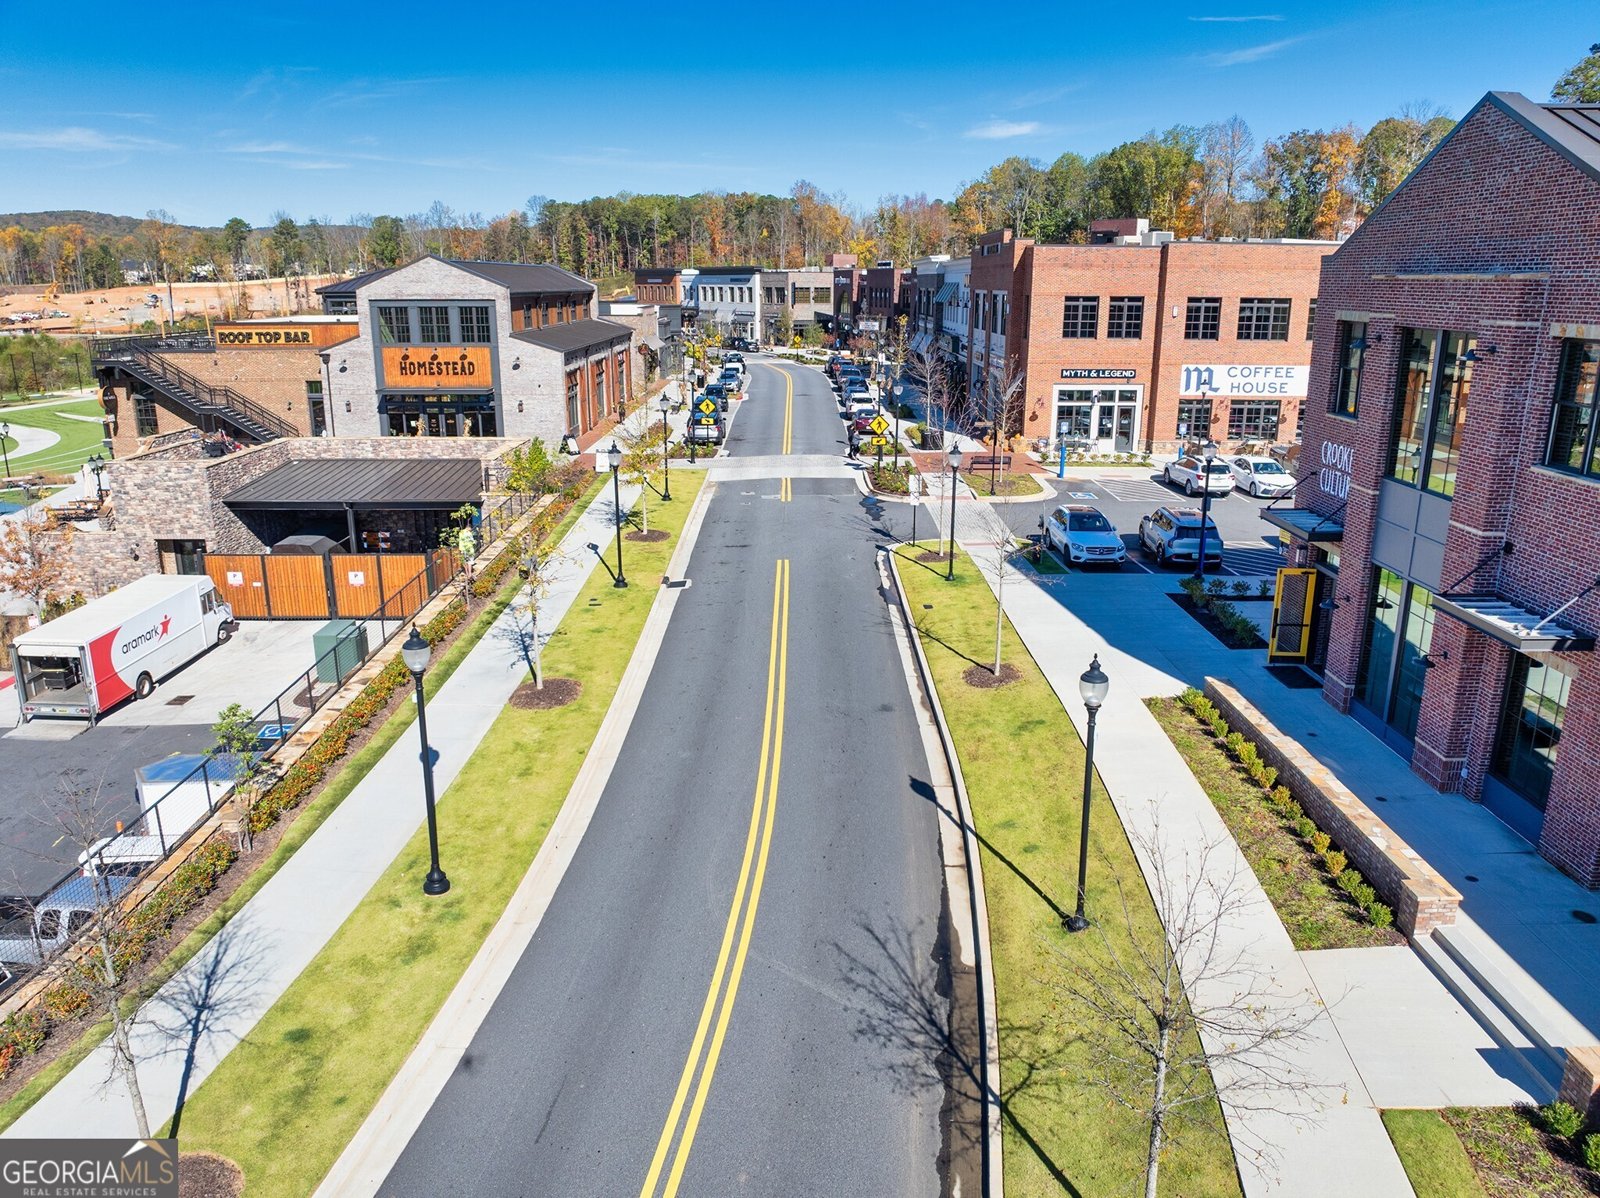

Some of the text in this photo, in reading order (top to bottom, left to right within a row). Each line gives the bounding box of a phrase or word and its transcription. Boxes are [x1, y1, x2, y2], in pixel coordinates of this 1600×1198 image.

[218, 331, 311, 344] ROOF TOP BAR
[400, 361, 476, 376] HOMESTEAD
[1227, 366, 1295, 378] COFFEE
[1230, 382, 1288, 393] HOUSE
[121, 624, 160, 654] aramark
